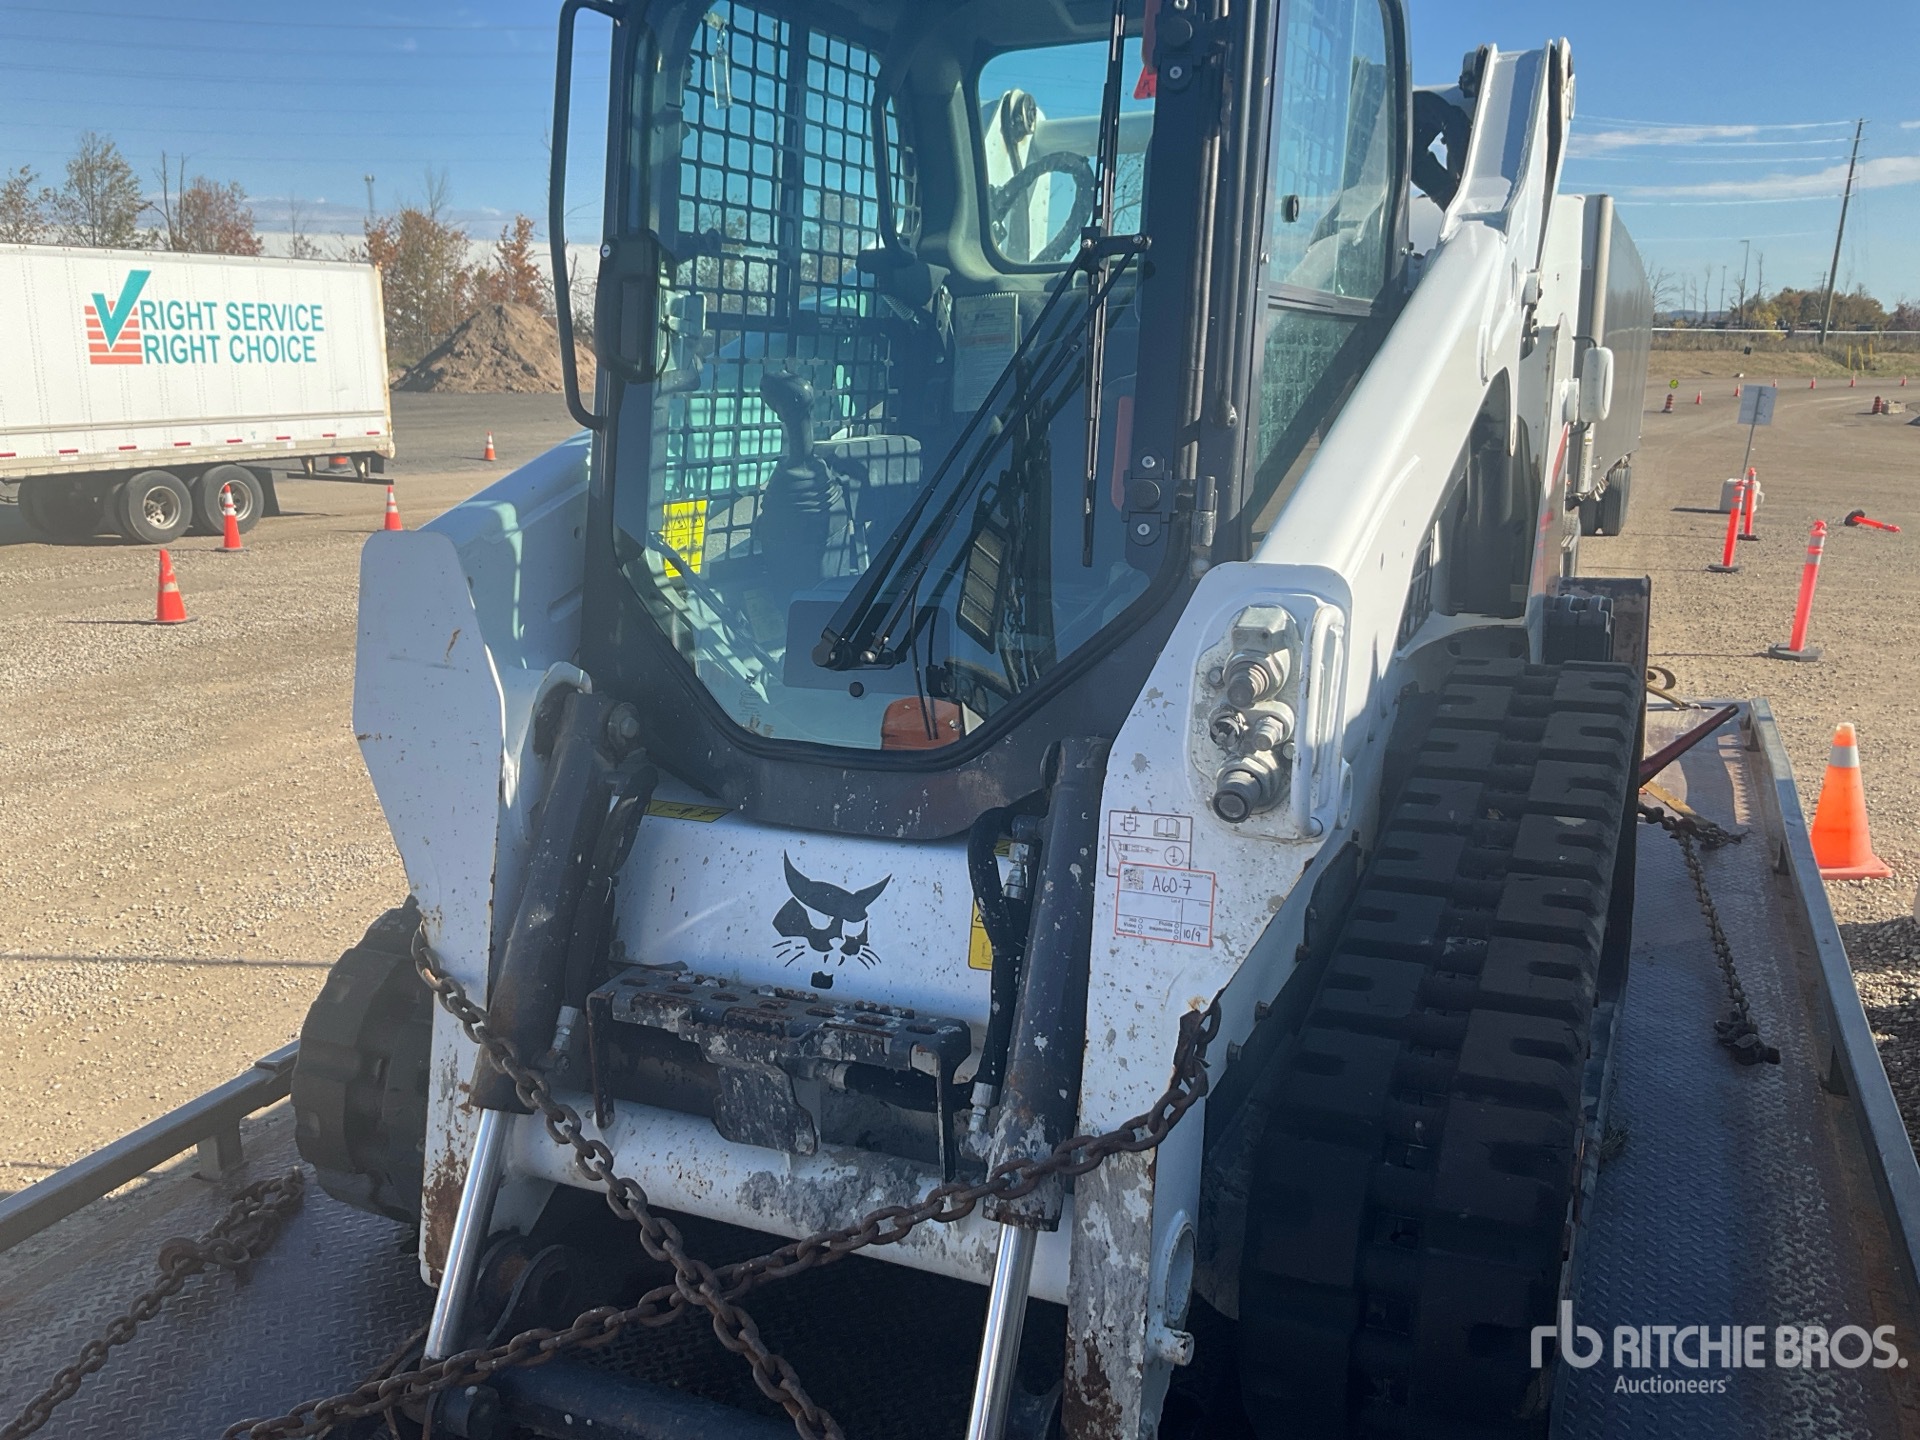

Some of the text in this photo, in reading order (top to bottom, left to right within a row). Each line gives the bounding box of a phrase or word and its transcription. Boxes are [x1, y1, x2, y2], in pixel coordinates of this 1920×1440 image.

[140, 300, 325, 332] RIGHT SERVICE
[143, 335, 317, 364] RIGHT CHOICE
